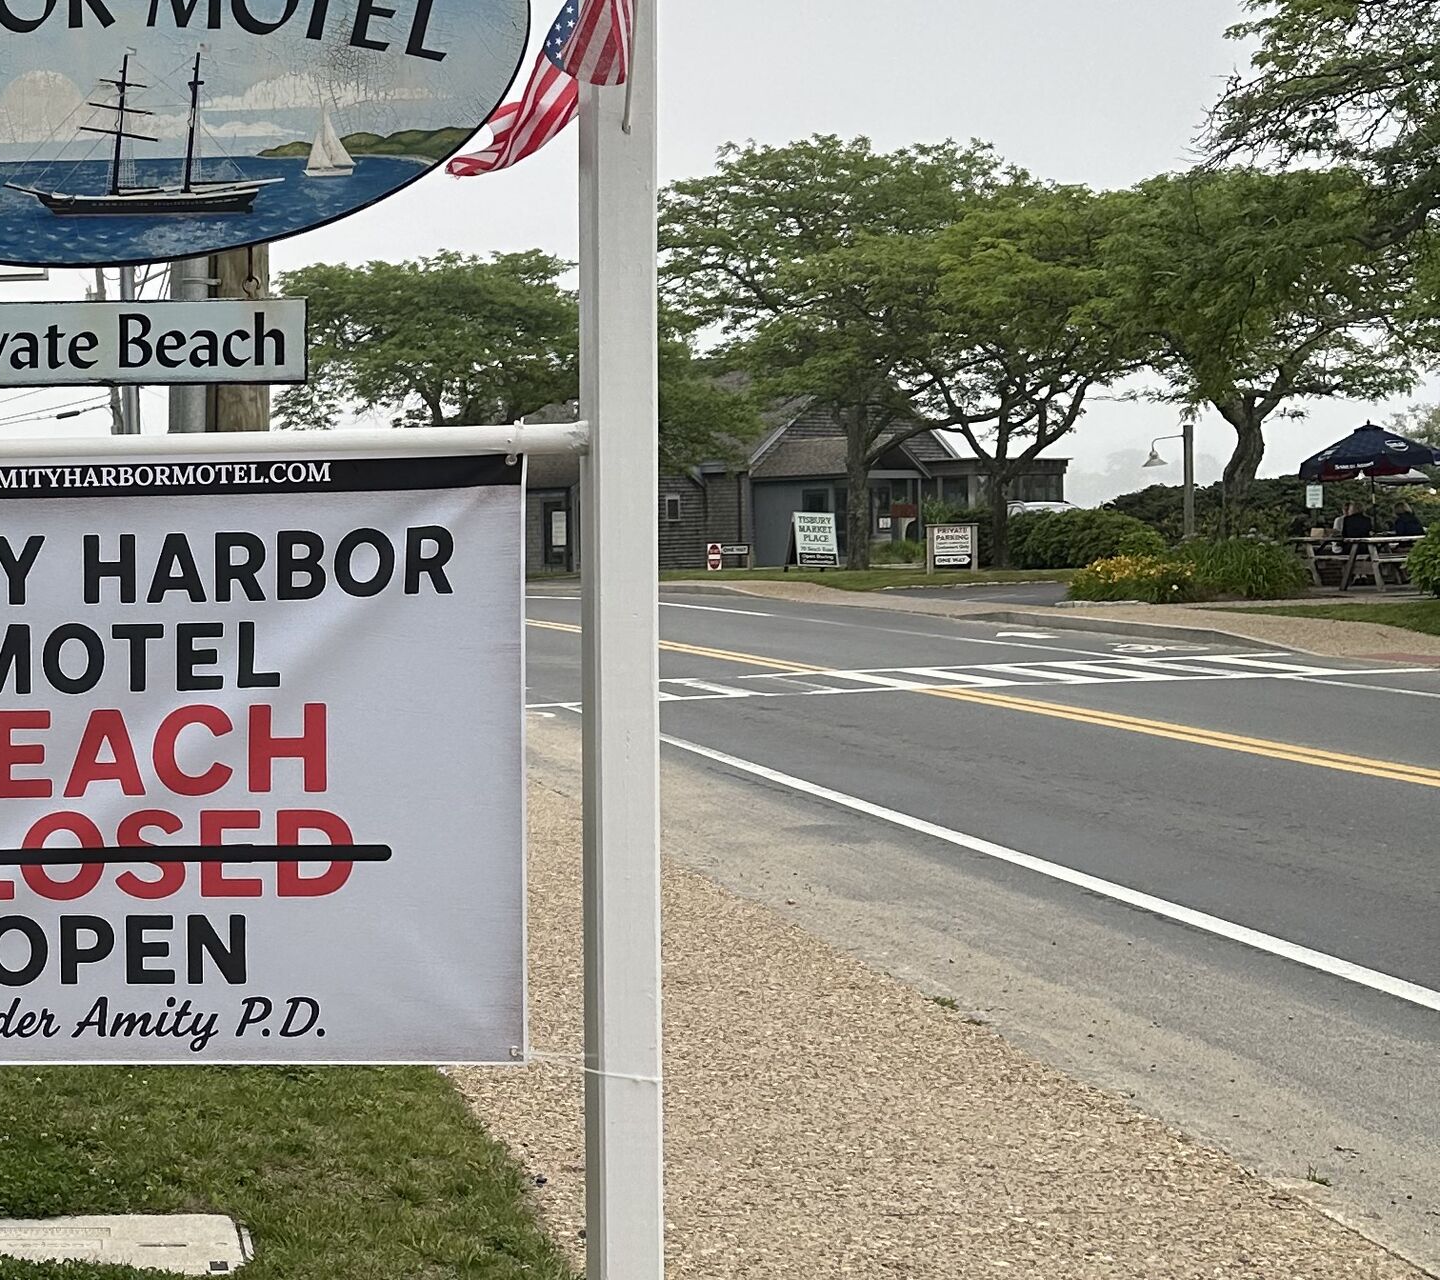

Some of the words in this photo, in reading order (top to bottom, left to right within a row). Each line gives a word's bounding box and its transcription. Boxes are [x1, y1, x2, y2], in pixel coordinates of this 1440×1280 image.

[118, 311, 286, 369] Beach
[798, 525, 833, 534] MARKET
[803, 534, 830, 543] PLACE
[82, 525, 455, 604] HARBOR
[71, 996, 219, 1052] Amity
[235, 996, 327, 1039] P.D.
